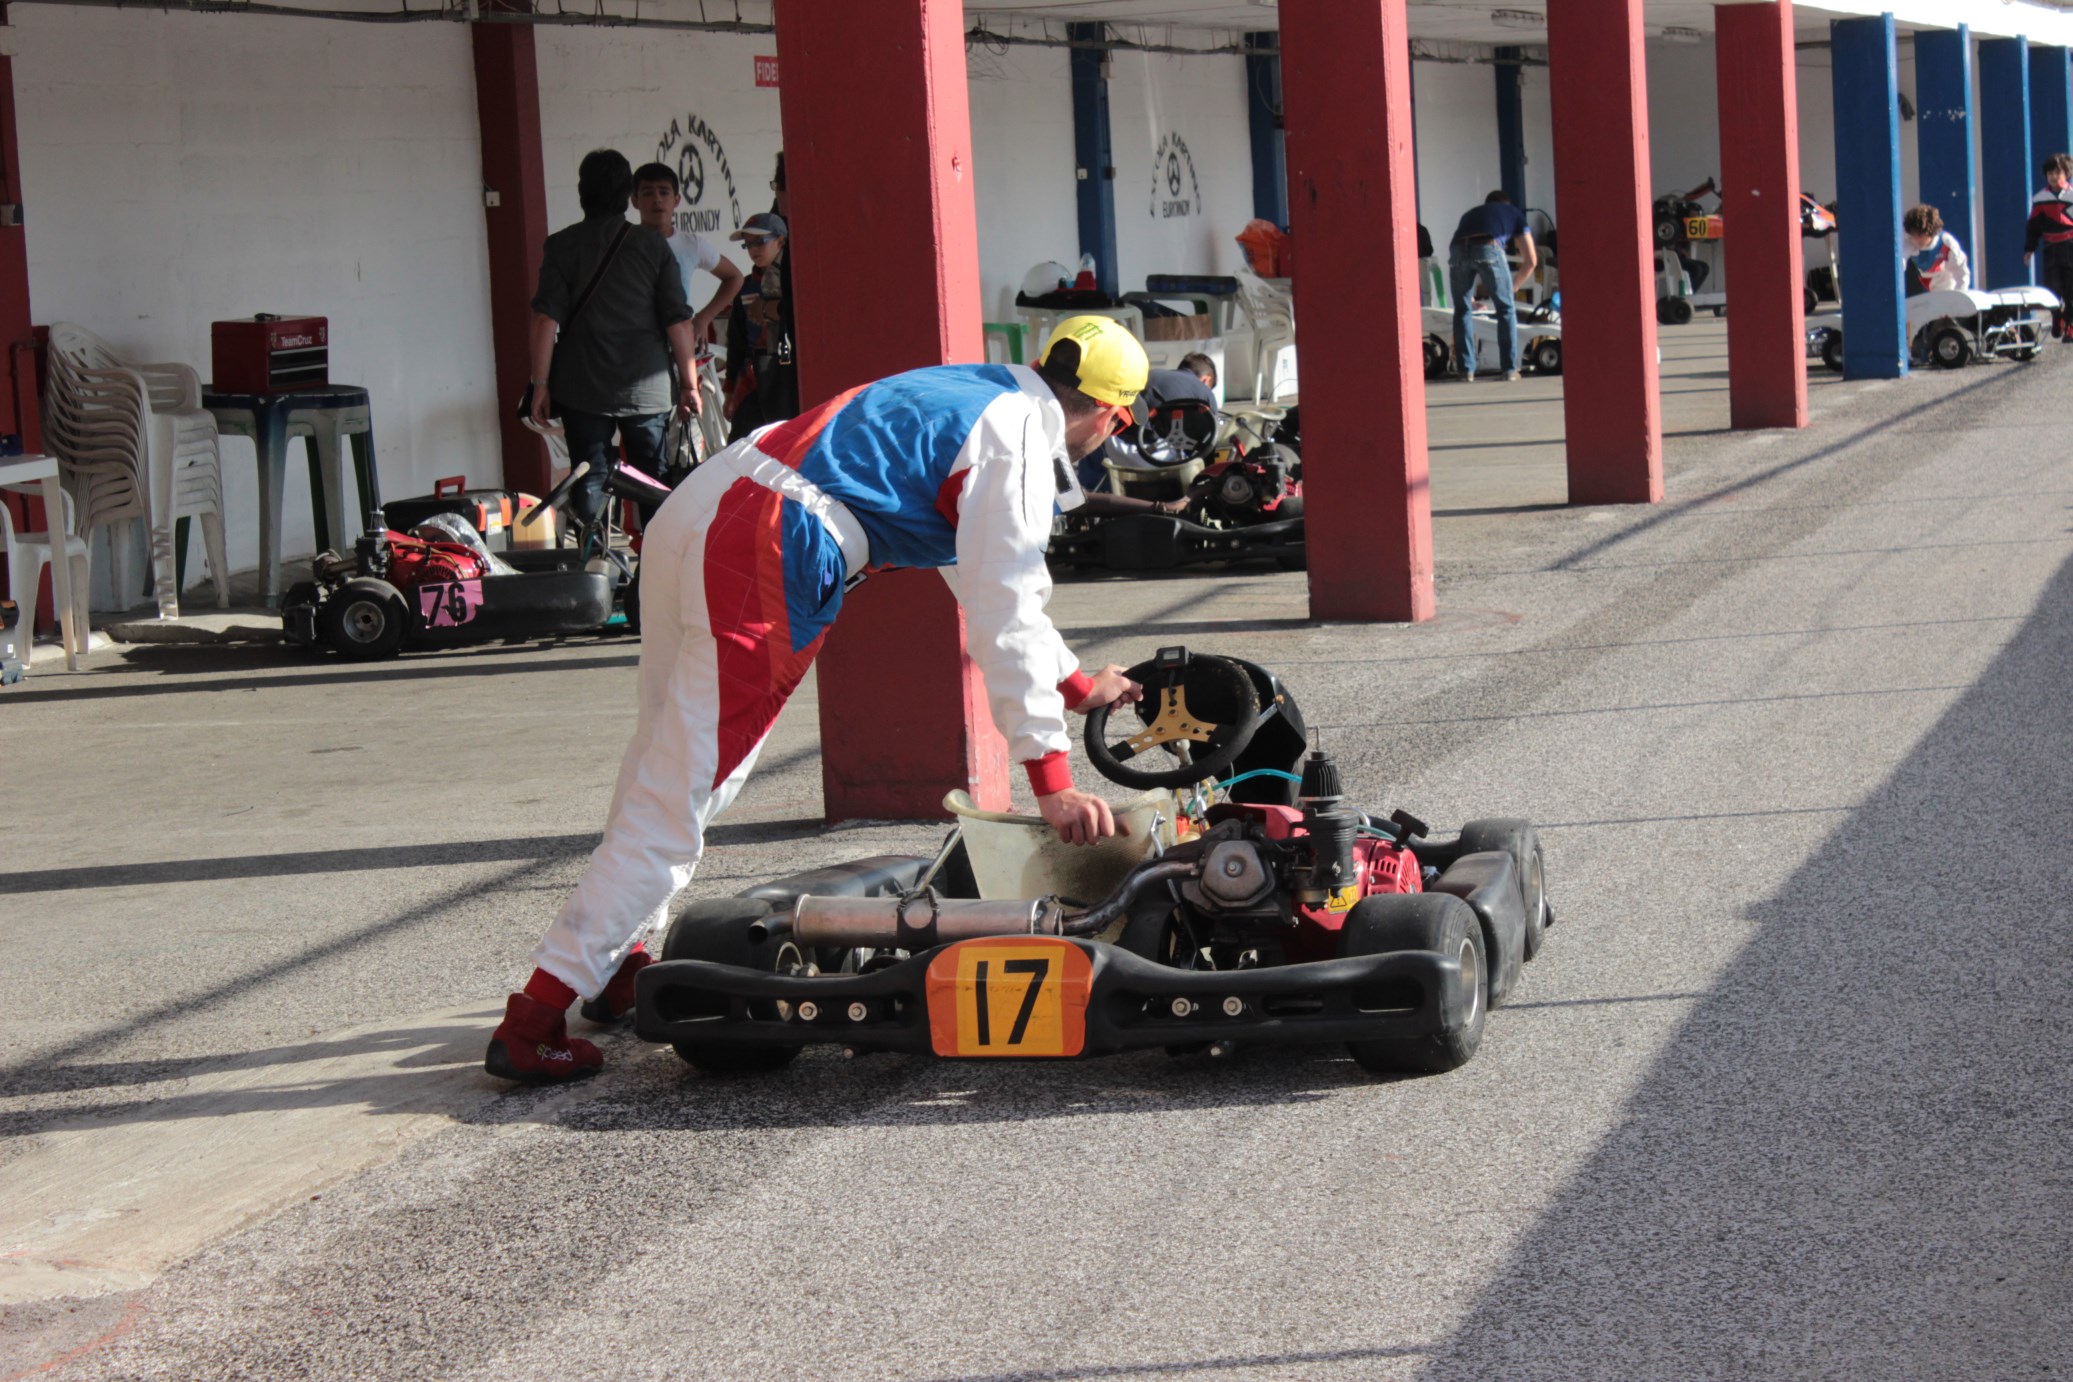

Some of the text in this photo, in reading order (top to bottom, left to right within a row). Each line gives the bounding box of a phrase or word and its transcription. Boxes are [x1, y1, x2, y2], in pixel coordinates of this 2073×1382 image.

[688, 113, 742, 229] KARTING
[1688, 219, 1706, 236] 60
[281, 334, 312, 347] TeamCruz
[422, 583, 467, 626] 76
[976, 959, 1049, 1046] 17
